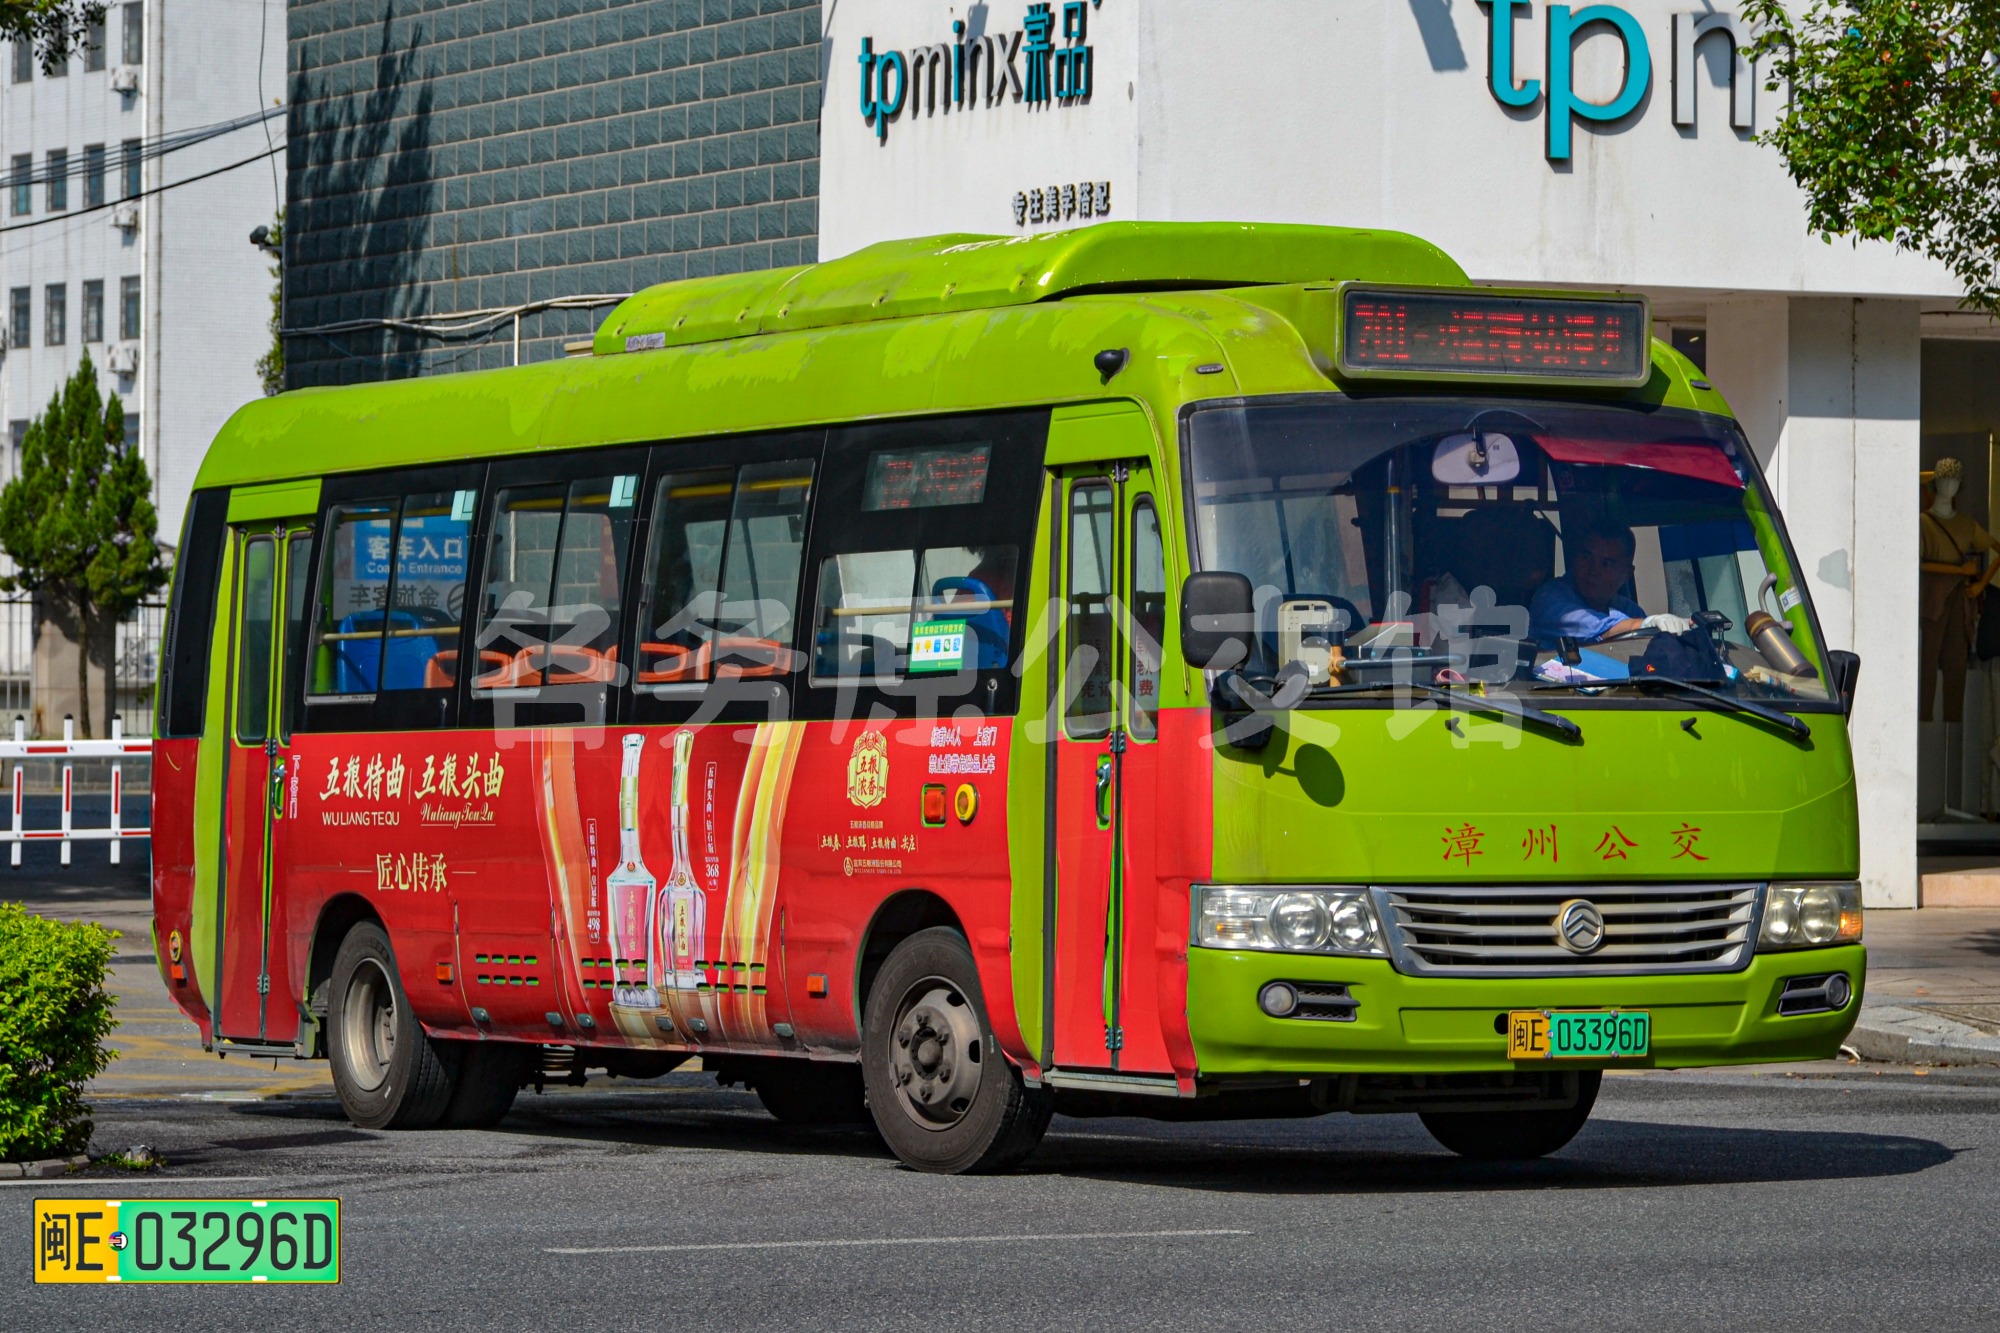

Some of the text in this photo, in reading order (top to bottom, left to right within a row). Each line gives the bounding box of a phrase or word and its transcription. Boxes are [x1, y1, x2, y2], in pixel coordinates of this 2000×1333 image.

[1012, 181, 1109, 223] 专注美学搭配
[1355, 304, 1408, 359] 701
[367, 535, 462, 560] 客车入口
[366, 562, 462, 574] Coah Entrance
[973, 726, 998, 746] 上客门
[414, 752, 505, 800] 五粮头曲
[856, 755, 879, 775] 五粮
[928, 753, 996, 774] 禁止携带危险品上车
[319, 753, 406, 801] 五粮特曲
[857, 776, 877, 796] 浓香
[1441, 822, 1710, 868] 漳州公交
[376, 852, 447, 892] 匠心传承
[706, 864, 720, 877] 368
[587, 918, 600, 931] 498
[1513, 1018, 1647, 1051] 闽E 03396D
